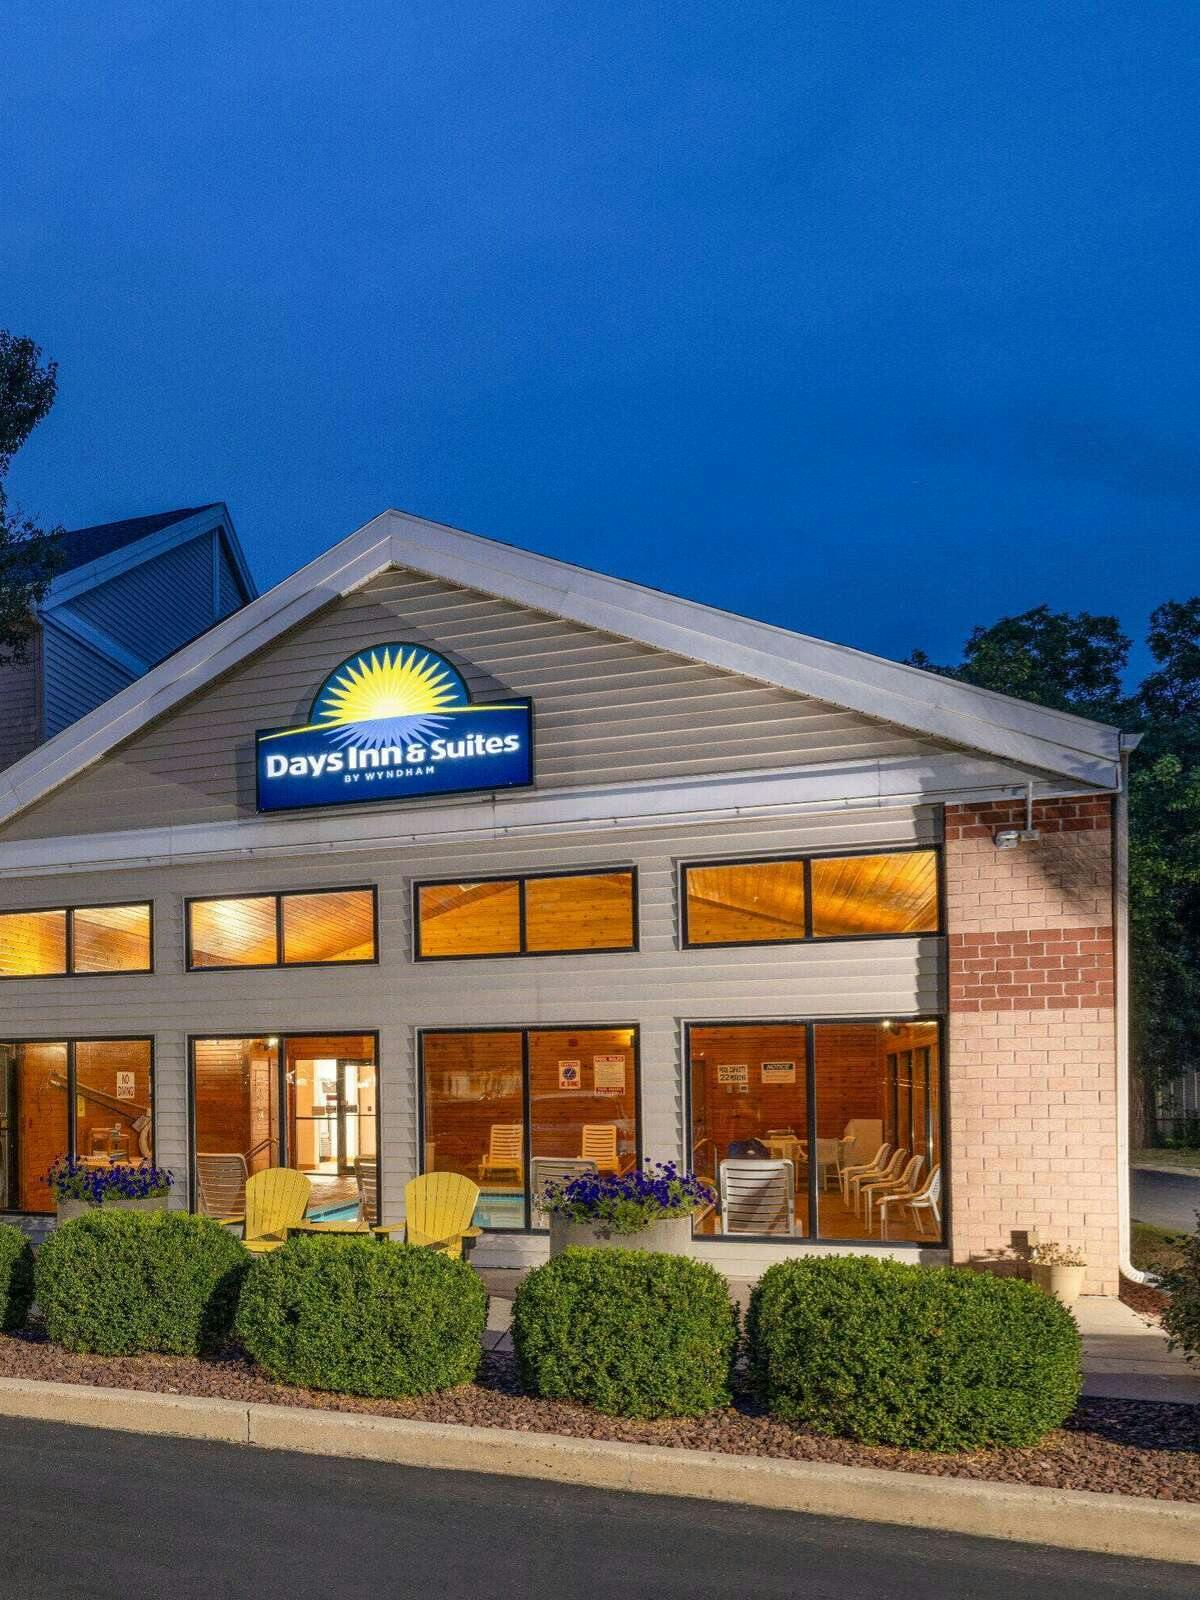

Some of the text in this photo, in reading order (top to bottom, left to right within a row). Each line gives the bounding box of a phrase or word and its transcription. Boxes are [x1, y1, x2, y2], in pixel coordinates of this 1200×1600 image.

[266, 734, 520, 777] Days Inn & Suites
[344, 766, 435, 783] BY WYNDHAM
[121, 1073, 130, 1085] NO
[118, 1086, 134, 1097] DIVING
